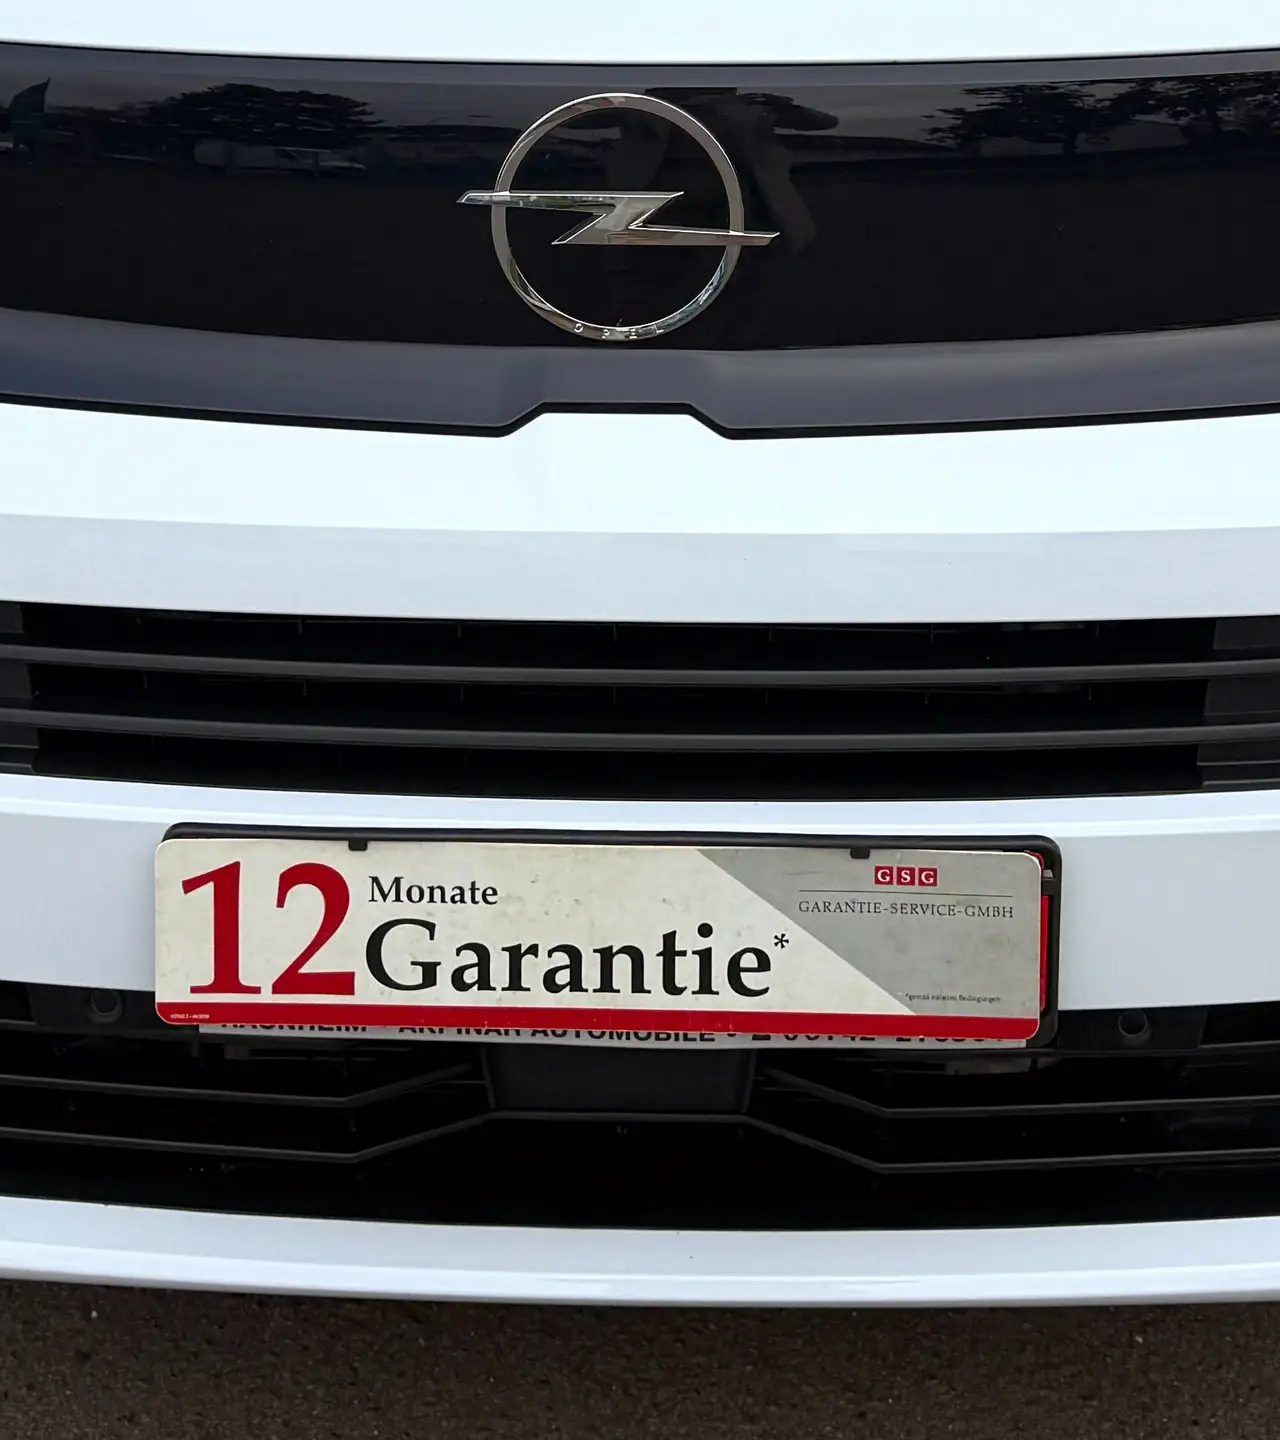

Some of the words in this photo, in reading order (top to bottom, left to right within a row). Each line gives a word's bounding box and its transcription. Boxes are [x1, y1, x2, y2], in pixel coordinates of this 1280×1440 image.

[875, 867, 936, 886] GSG
[798, 900, 1014, 919] GARANTIE-SERVICE-GMBH
[181, 861, 355, 996] 12
[368, 875, 499, 906] Monate
